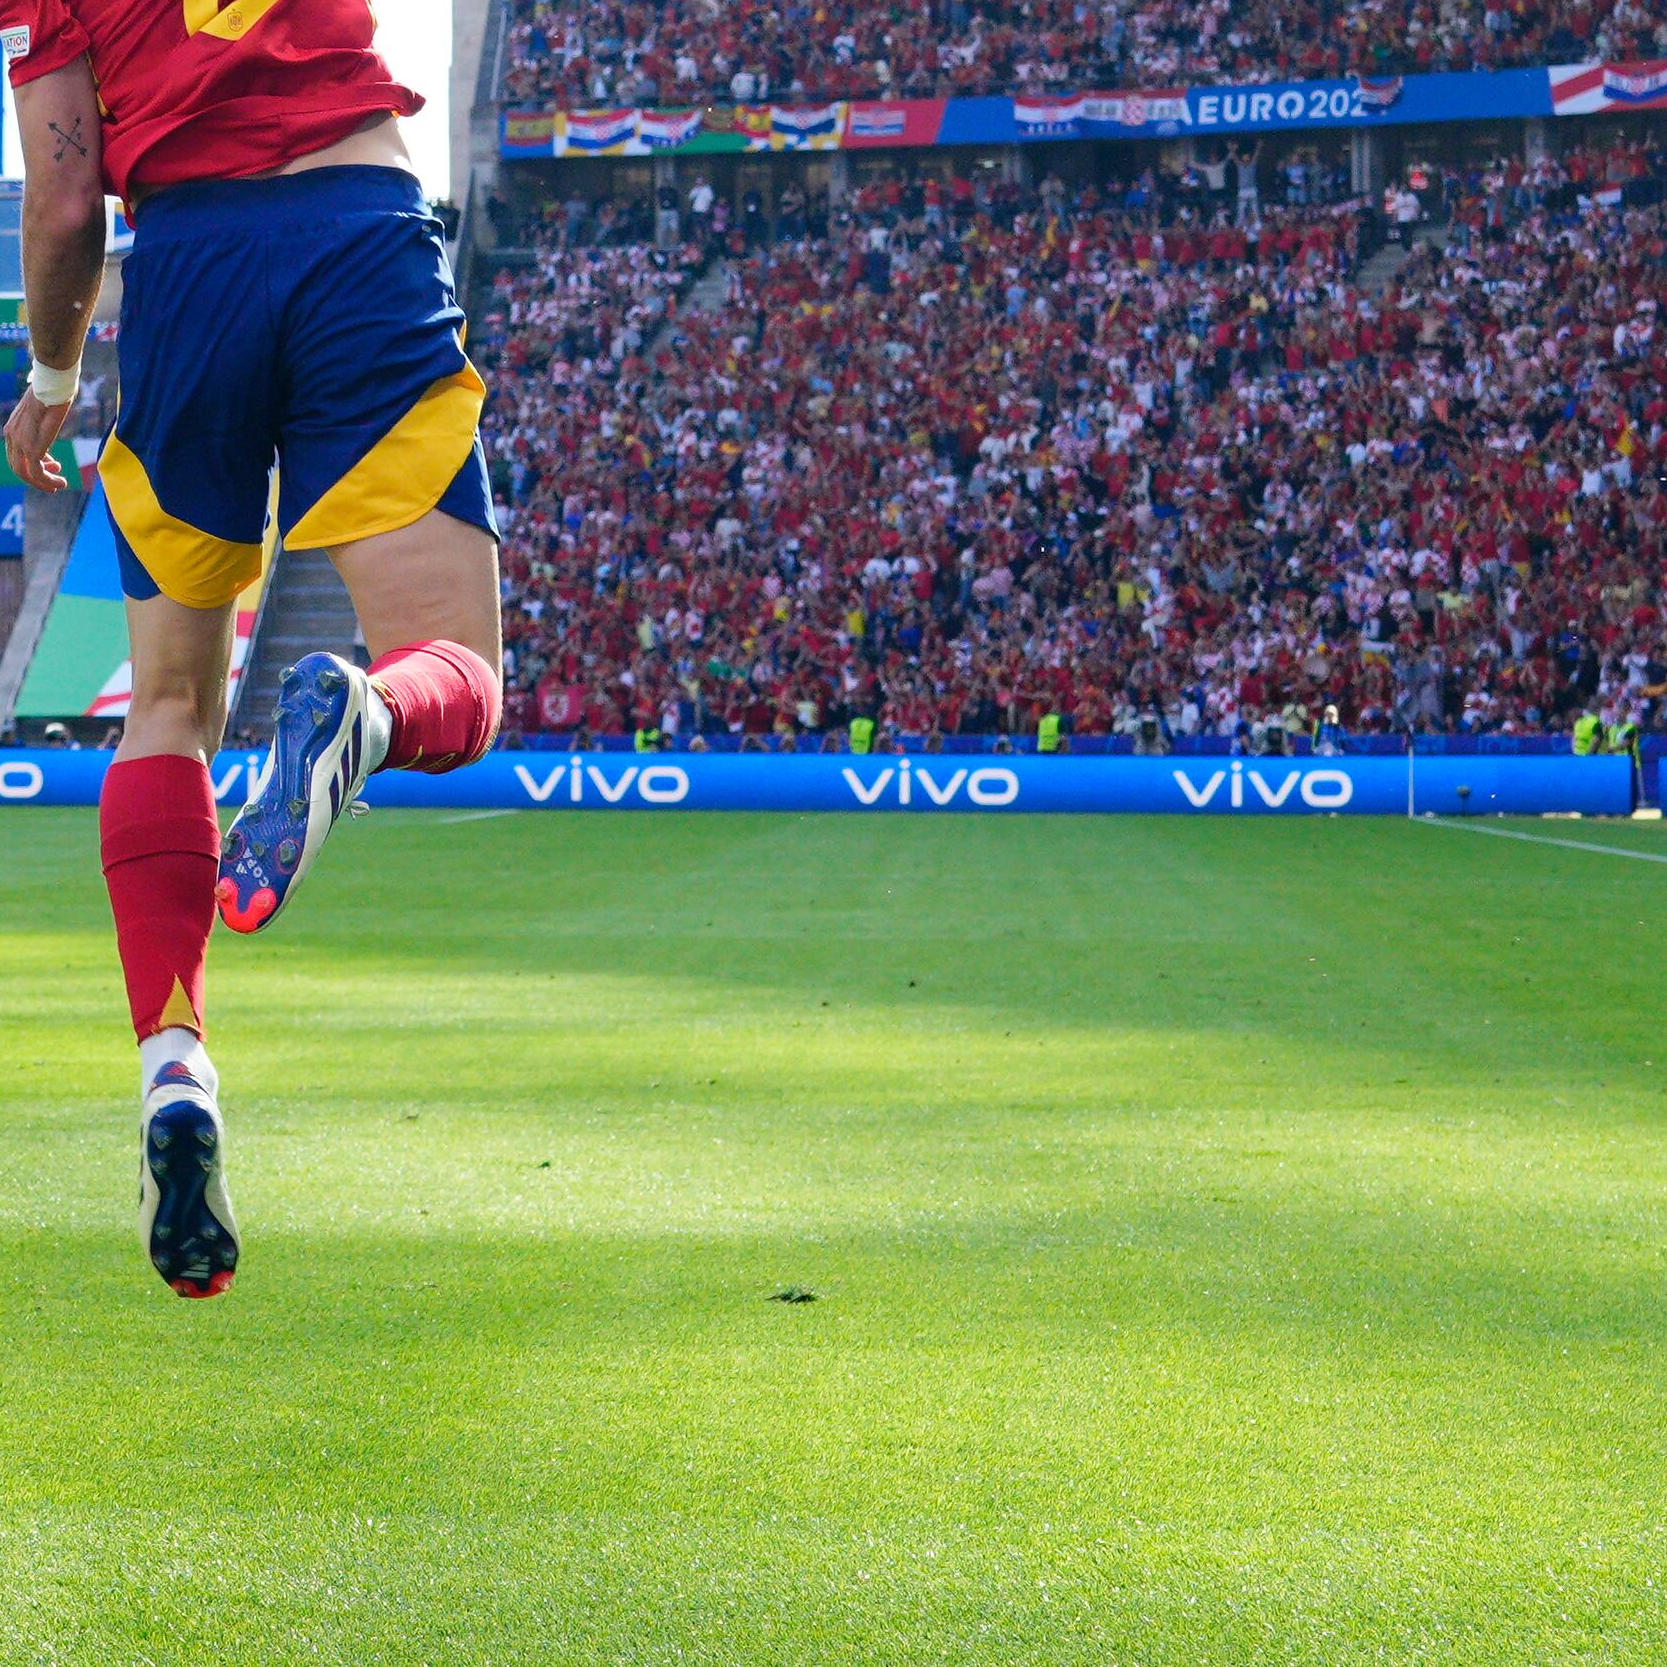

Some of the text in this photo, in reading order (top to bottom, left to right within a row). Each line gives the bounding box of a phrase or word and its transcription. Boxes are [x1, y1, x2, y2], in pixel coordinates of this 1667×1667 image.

[3, 35, 28, 48] ATION
[514, 756, 690, 803] vivo
[842, 758, 1020, 806] vivo
[1173, 761, 1354, 808] vivo
